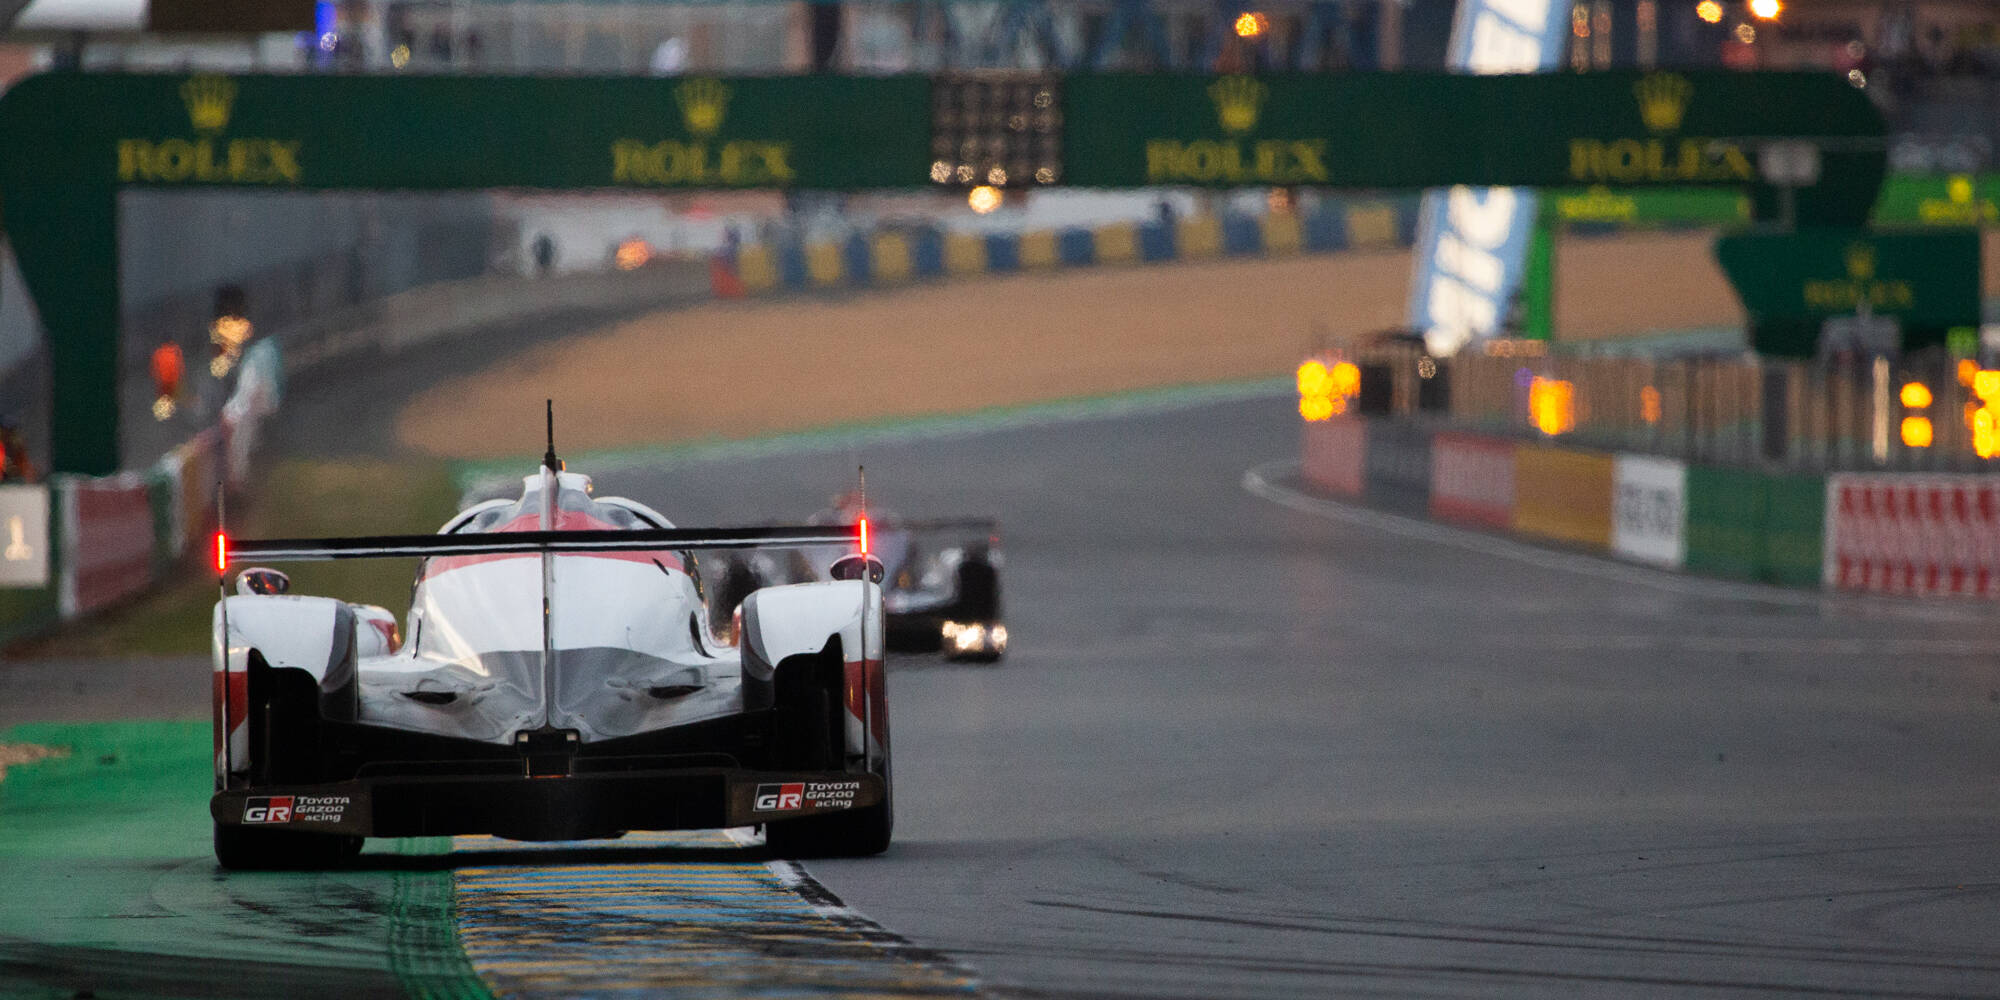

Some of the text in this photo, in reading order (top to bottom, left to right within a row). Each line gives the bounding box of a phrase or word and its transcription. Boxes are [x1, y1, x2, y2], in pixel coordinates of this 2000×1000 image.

[118, 138, 301, 182] ROLEX
[613, 140, 796, 184] ROLEX
[1146, 139, 1328, 181] ROLEX
[808, 782, 860, 791] TOYOTA
[297, 796, 350, 805] TOYOTA
[756, 793, 801, 809] GR
[806, 791, 854, 799] GAZOO
[245, 807, 290, 822] GR
[295, 805, 344, 813] GAZOO
